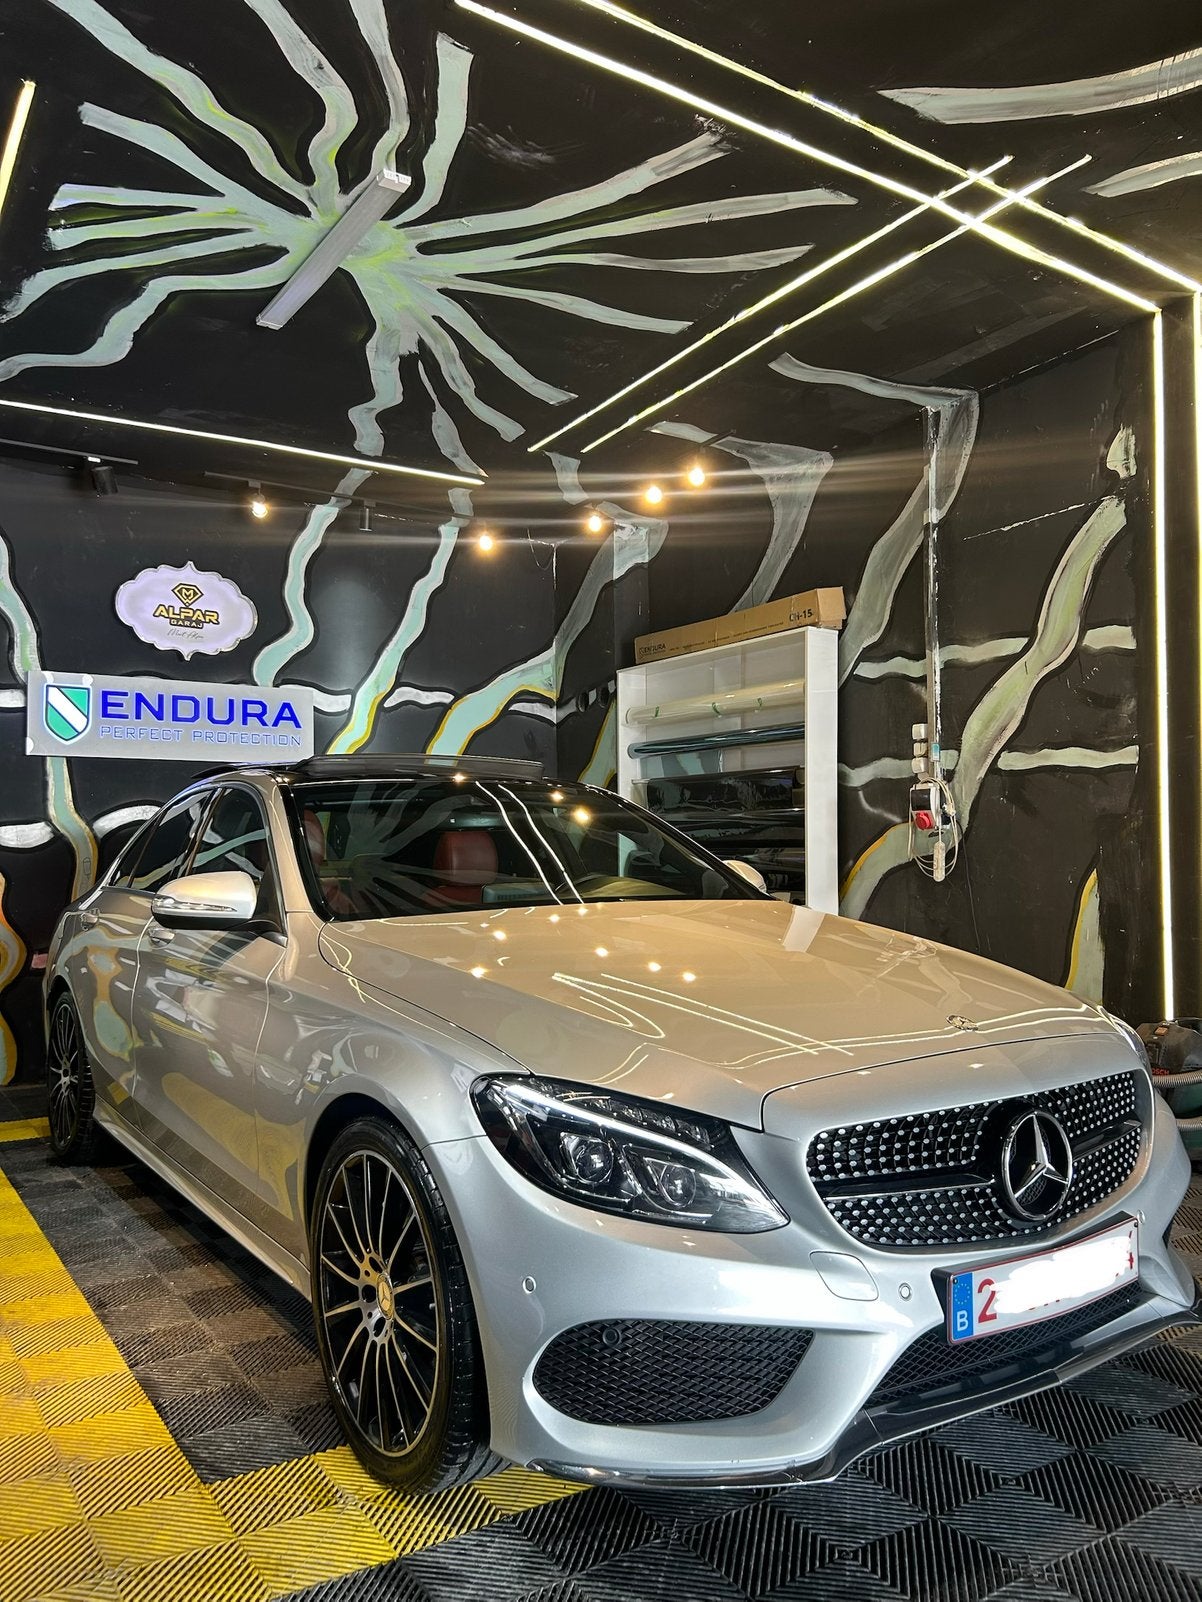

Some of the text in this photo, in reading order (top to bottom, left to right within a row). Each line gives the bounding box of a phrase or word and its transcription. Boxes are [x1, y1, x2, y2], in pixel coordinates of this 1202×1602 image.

[153, 604, 219, 624] ALPAR
[170, 619, 203, 628] GARAJ
[789, 609, 813, 621] CH-15
[101, 690, 302, 729] ENDURA
[100, 726, 301, 746] PERFECT PROTECTION
[957, 1310, 969, 1332] B
